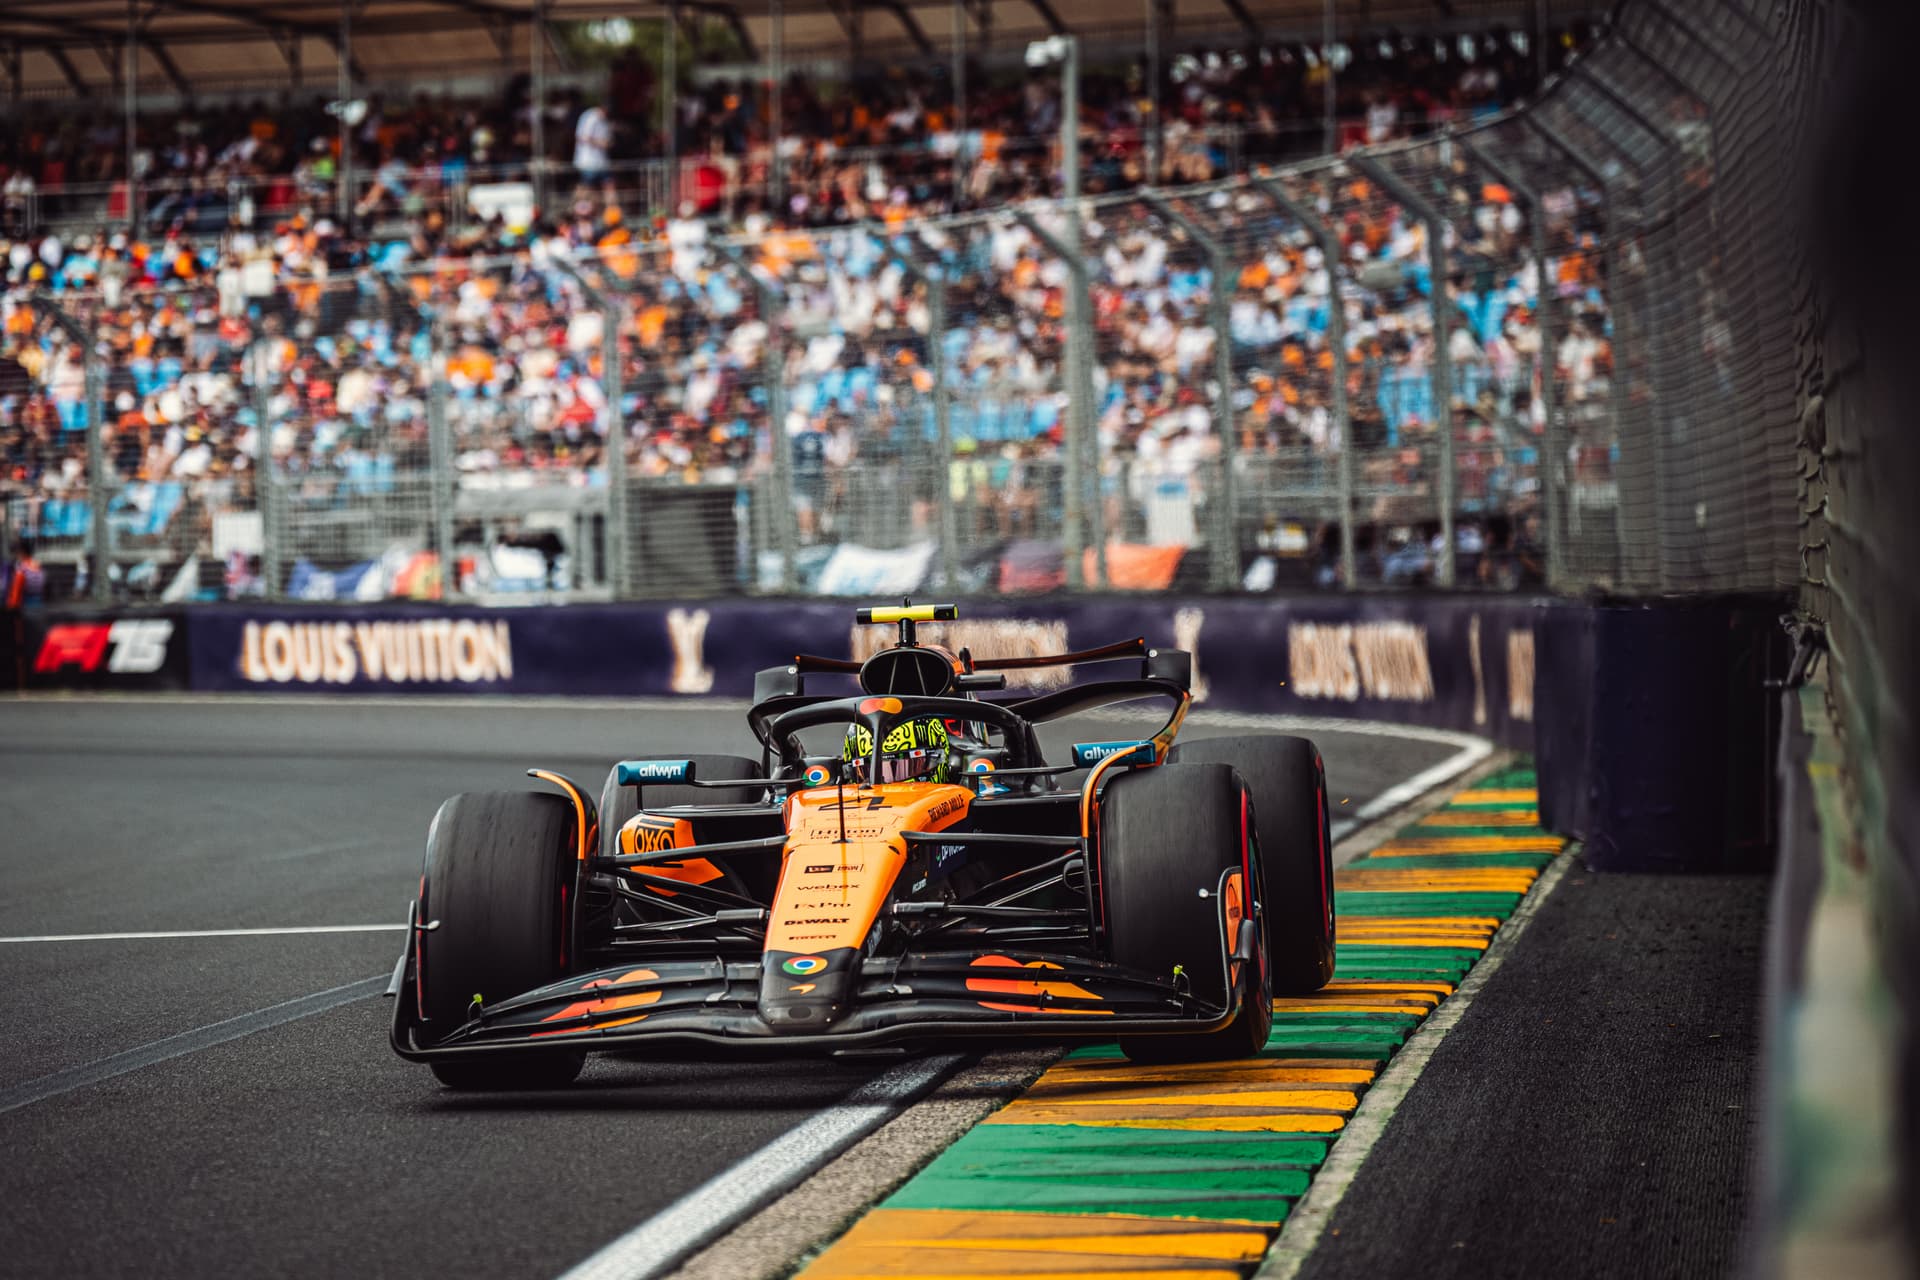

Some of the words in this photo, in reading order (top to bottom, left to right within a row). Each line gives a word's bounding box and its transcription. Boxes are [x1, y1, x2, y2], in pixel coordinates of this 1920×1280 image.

[242, 619, 356, 684] LOUIS
[355, 618, 513, 683] VUITTON
[639, 764, 681, 778] allwyn
